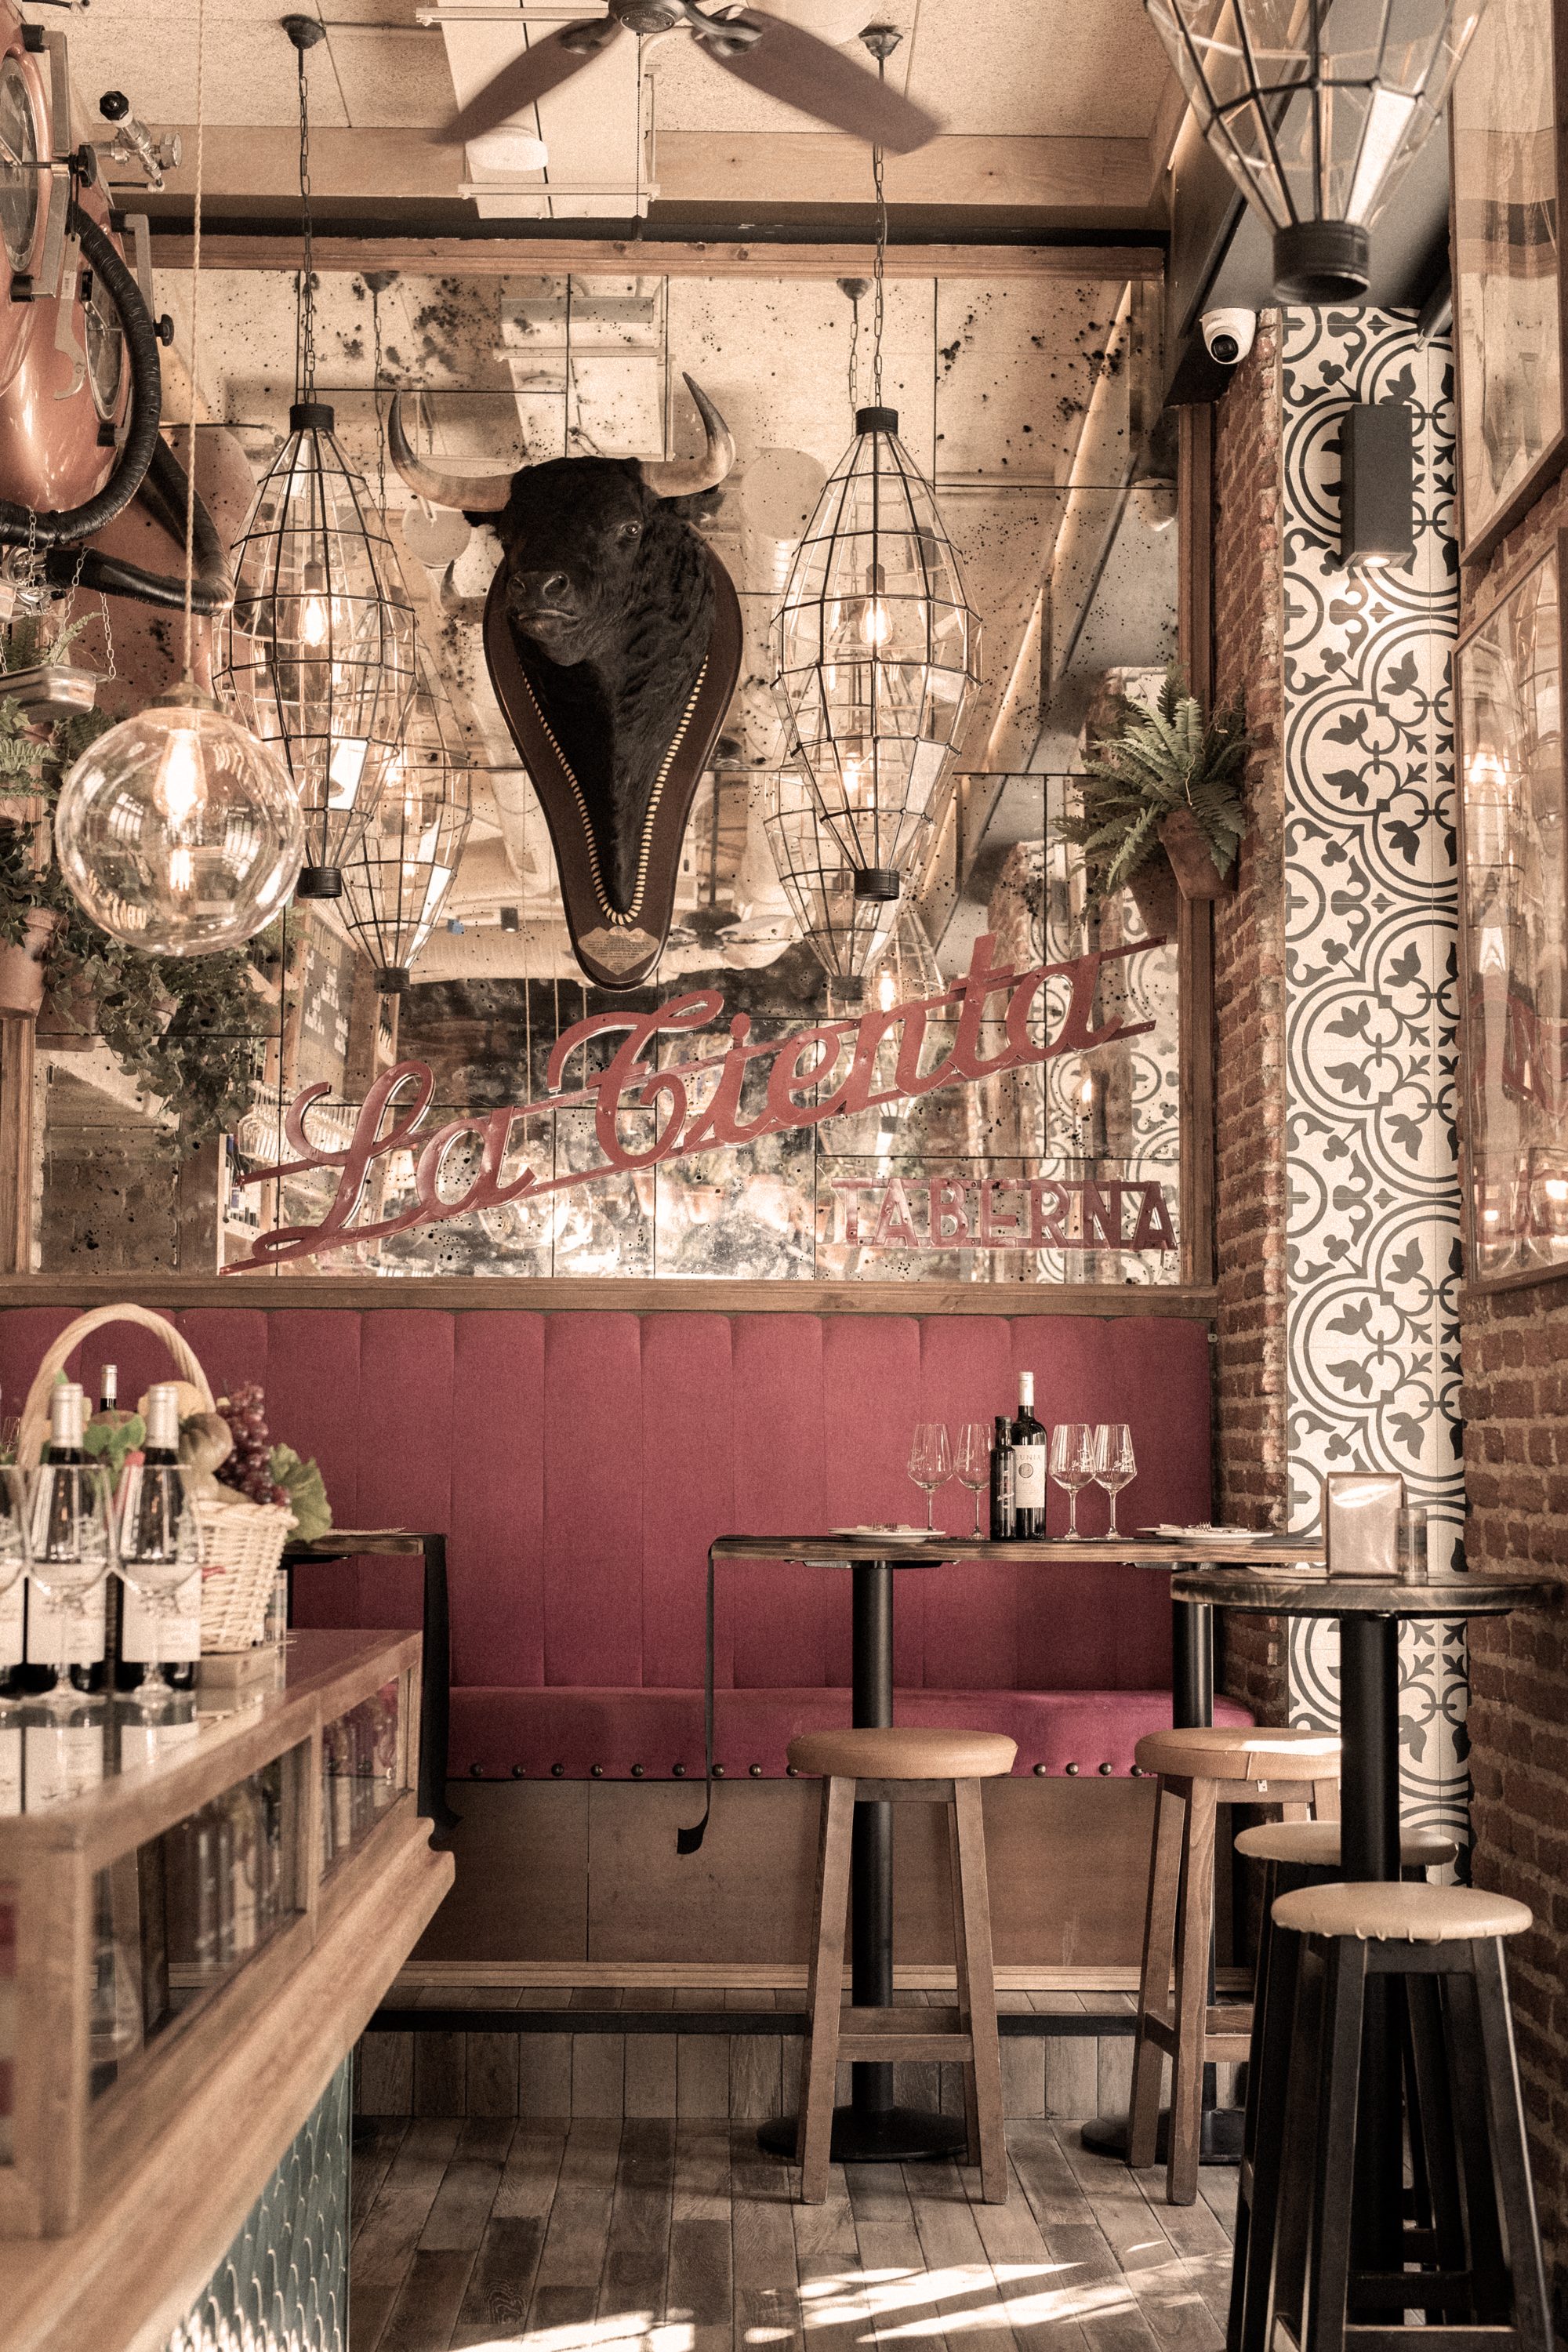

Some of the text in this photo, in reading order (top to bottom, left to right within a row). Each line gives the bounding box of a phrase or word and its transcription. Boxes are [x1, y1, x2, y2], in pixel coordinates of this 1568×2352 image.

[252, 1060, 536, 1261] La
[547, 932, 1123, 1169] Tienta
[831, 1177, 1178, 1250] TABERNA
